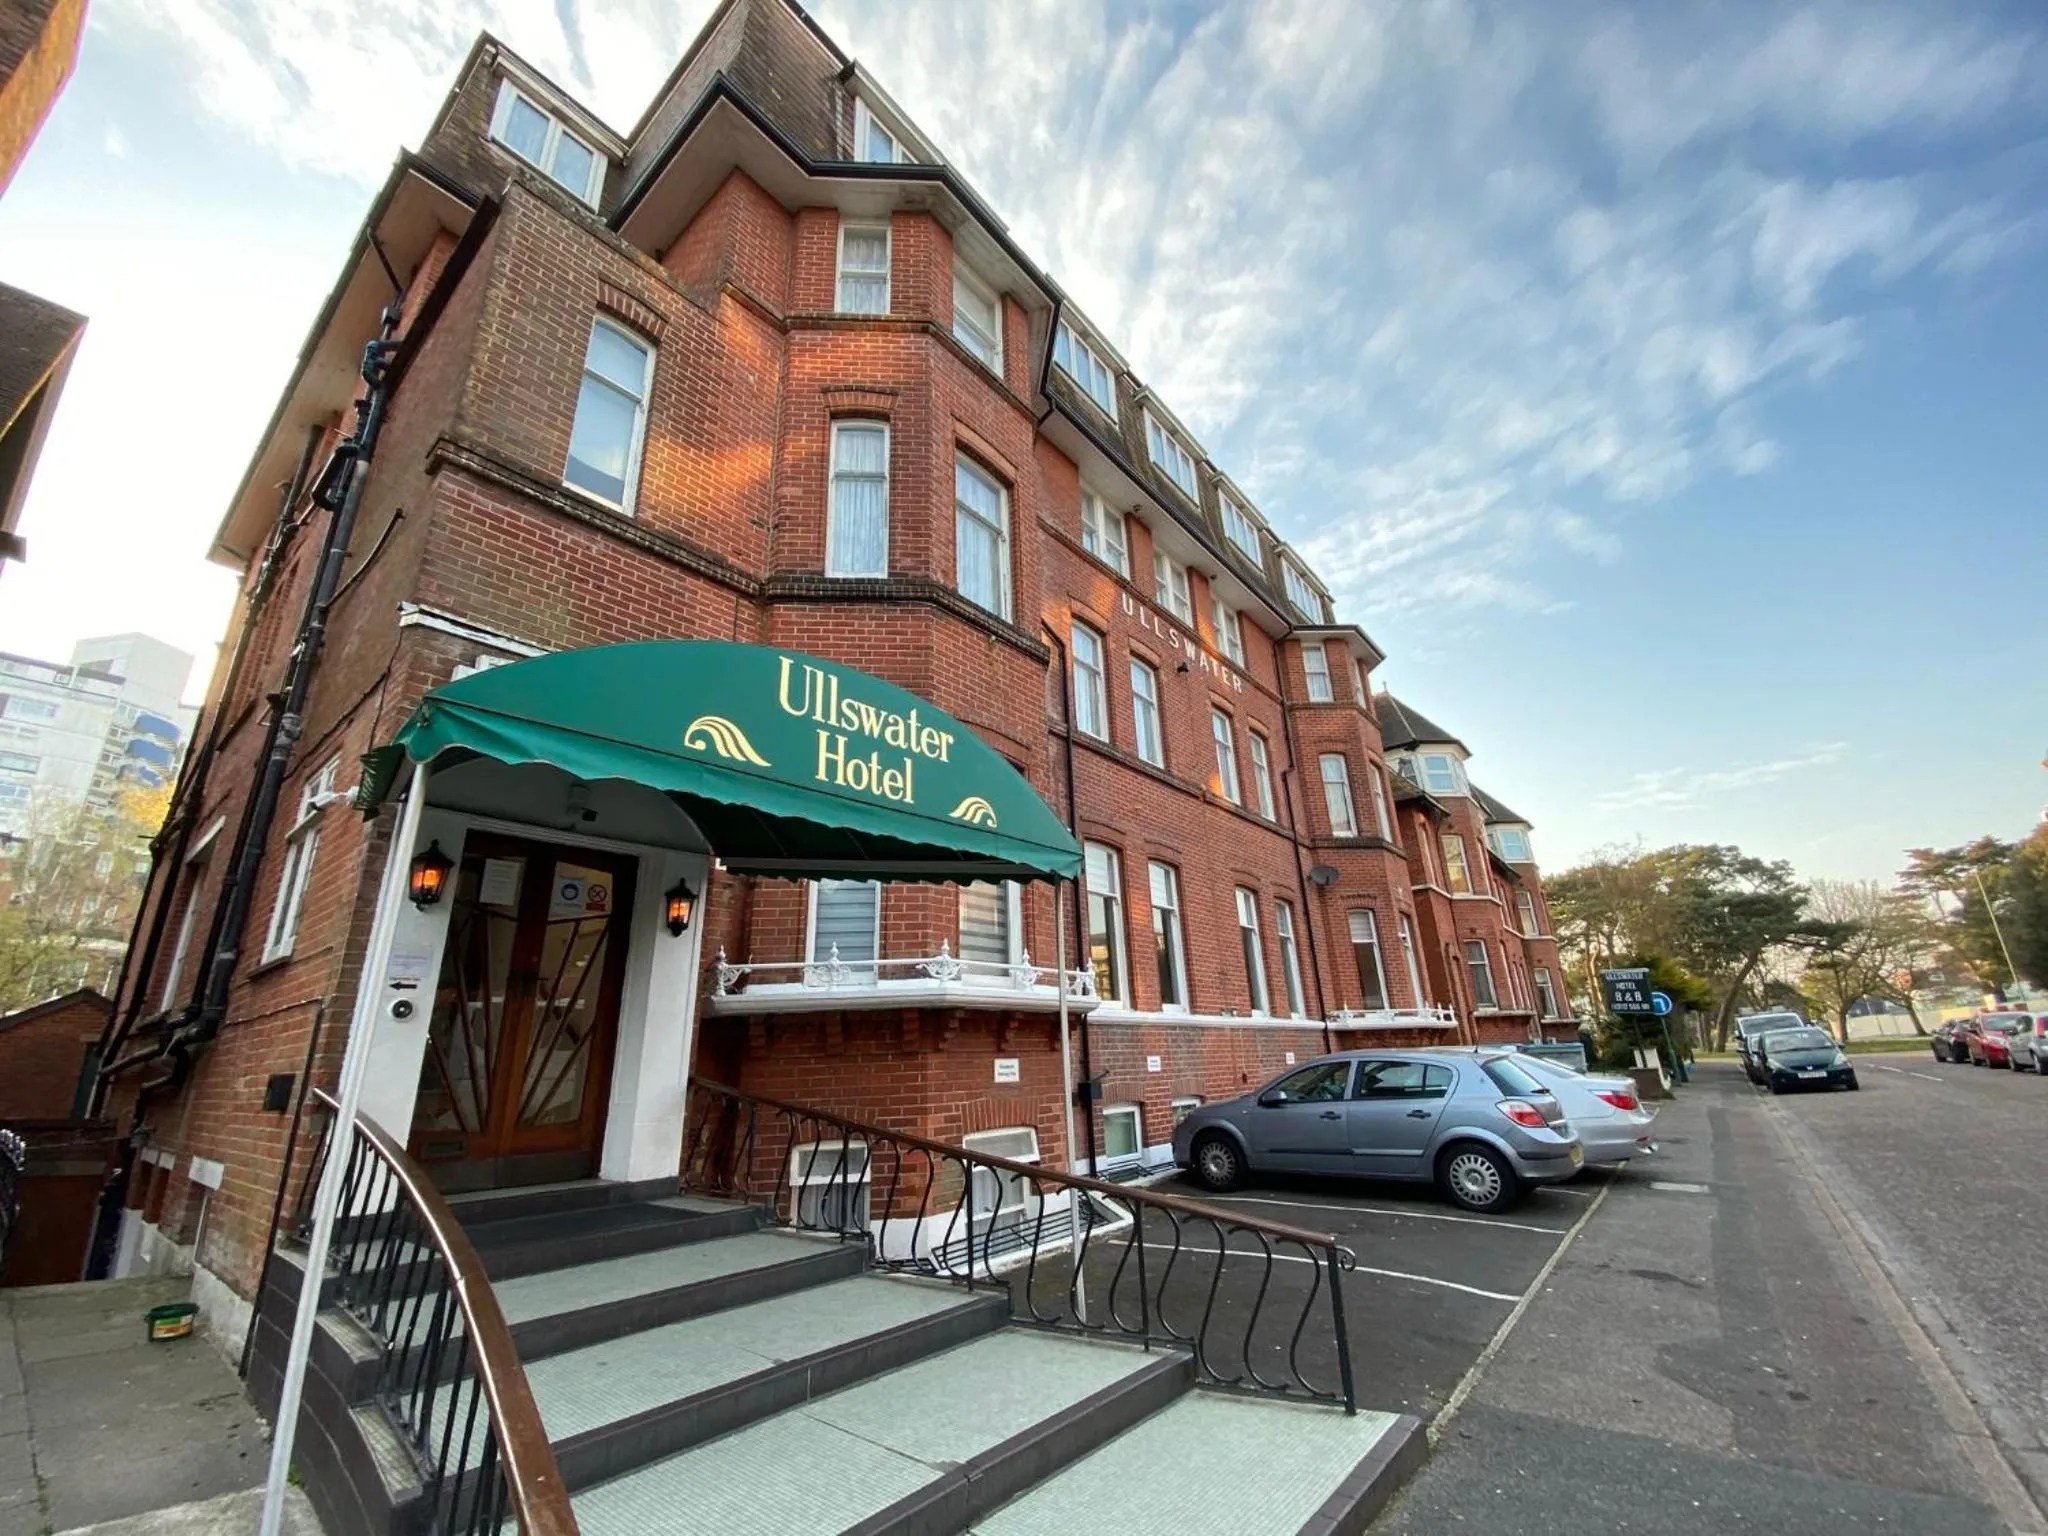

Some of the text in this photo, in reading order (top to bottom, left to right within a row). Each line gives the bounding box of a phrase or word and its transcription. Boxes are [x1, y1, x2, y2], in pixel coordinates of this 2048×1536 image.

[1122, 592, 1242, 694] ULLSWATER
[778, 655, 954, 763] Ullswater
[815, 728, 915, 804] Hotel
[1614, 991, 1642, 1002] B & B
